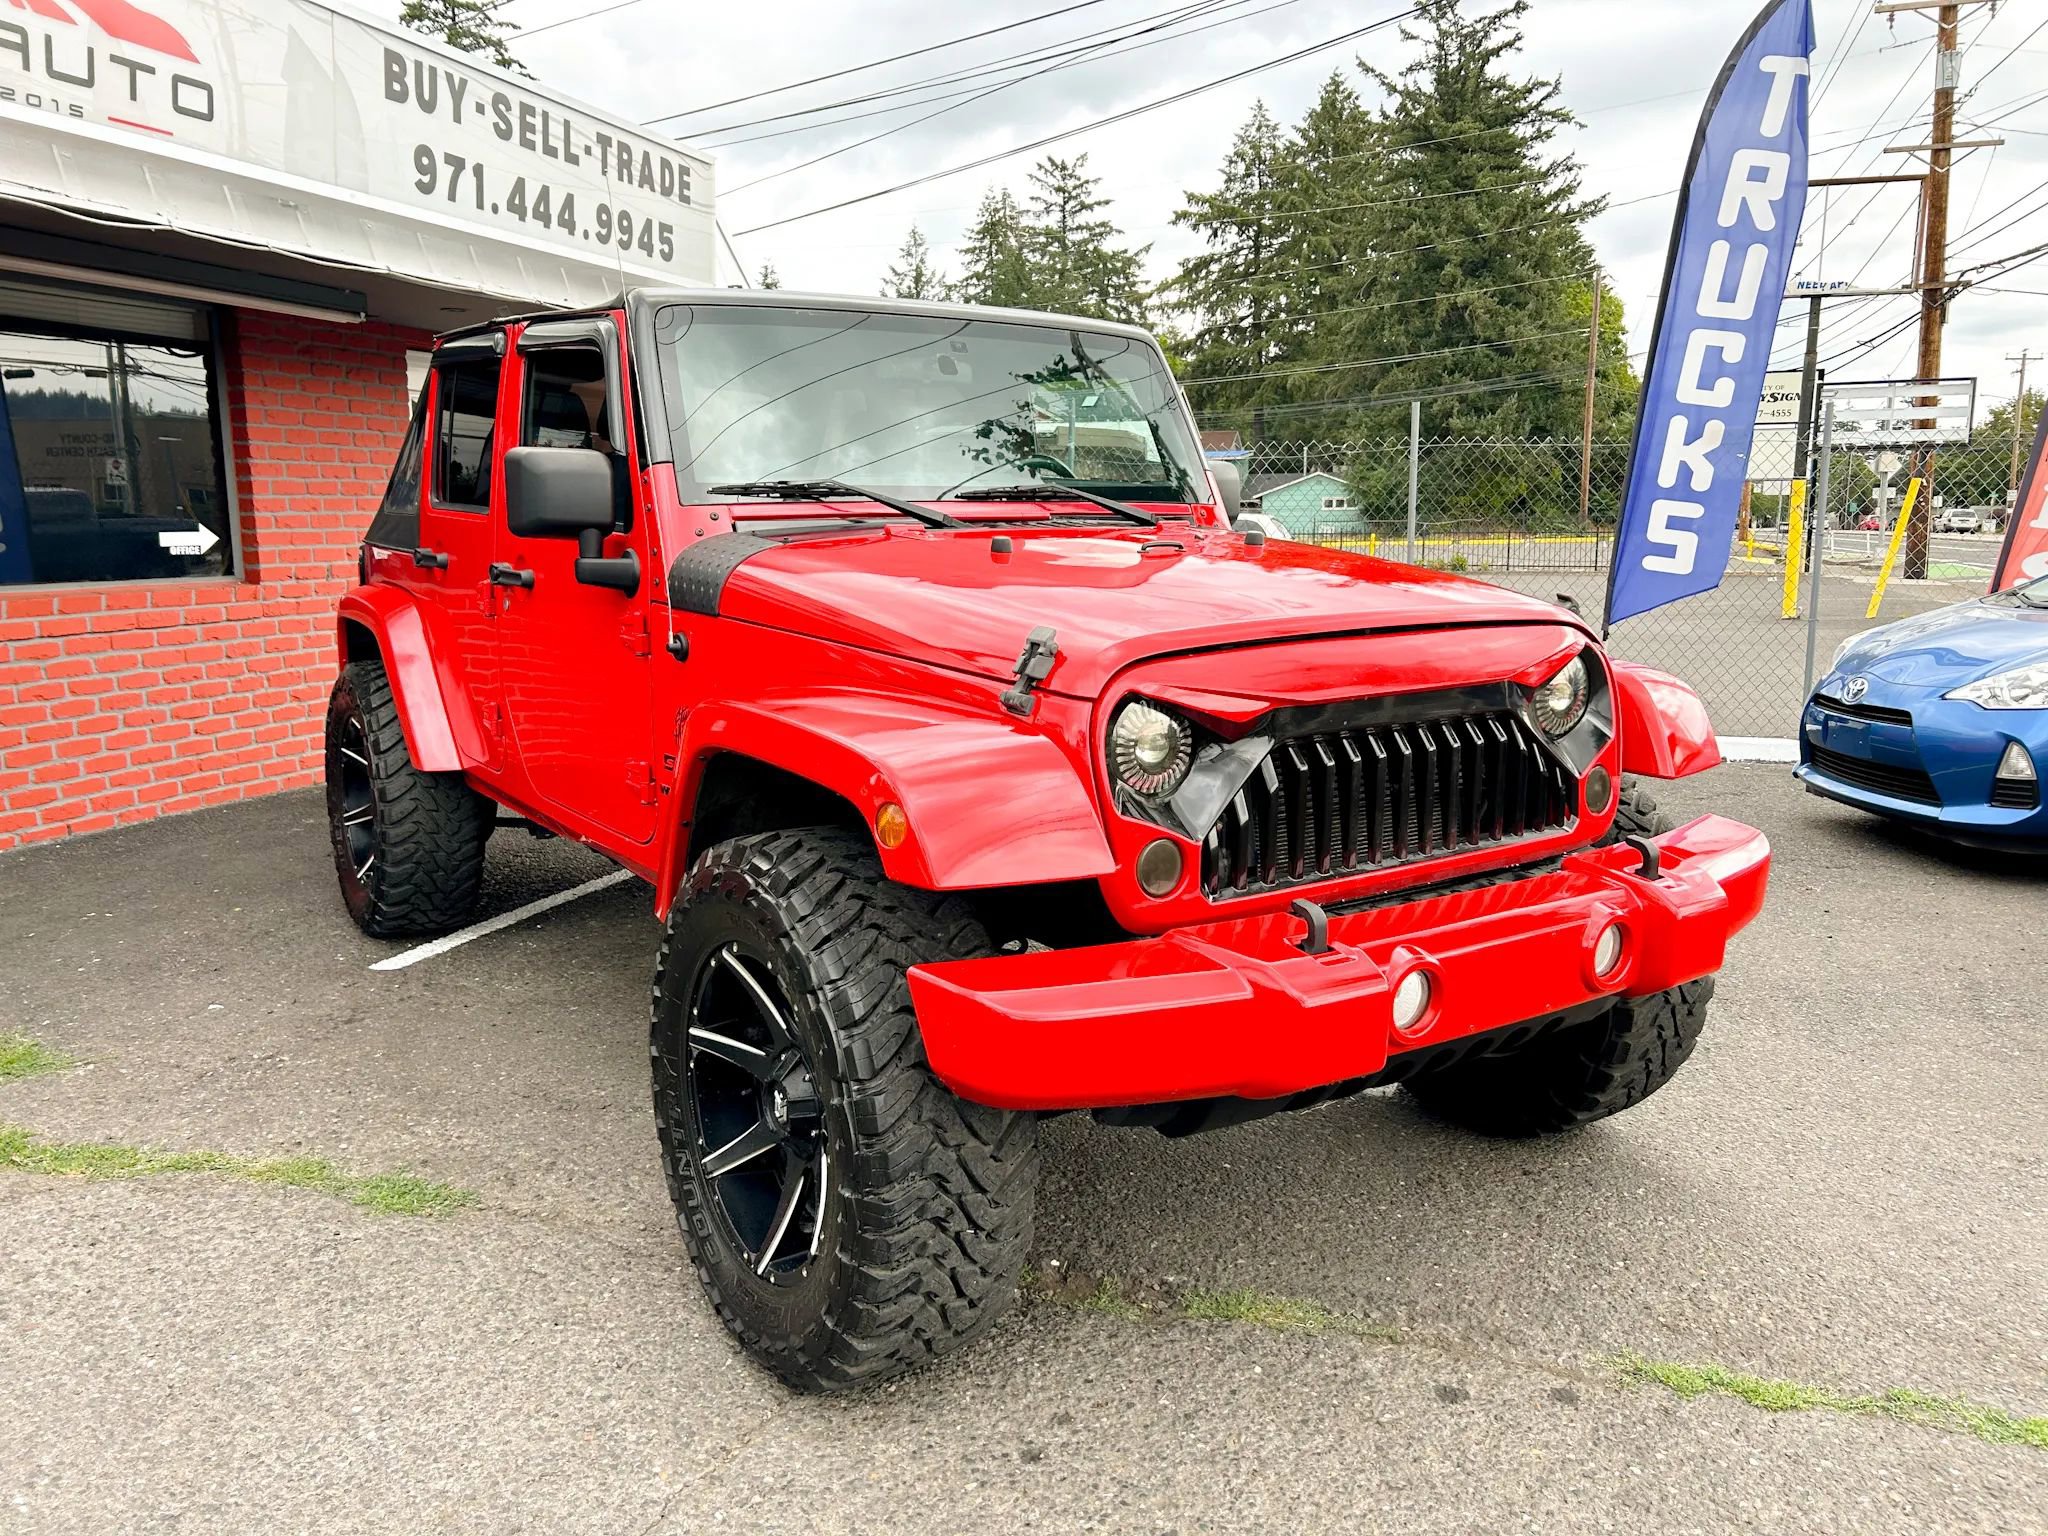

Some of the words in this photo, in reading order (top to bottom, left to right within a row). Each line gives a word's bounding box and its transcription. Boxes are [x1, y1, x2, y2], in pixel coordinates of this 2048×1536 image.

[0, 22, 214, 122] AUTO
[0, 86, 84, 119] 2015
[383, 46, 692, 206] BUY-SELL-TRADE
[413, 143, 674, 263] 971.444.9945
[1641, 55, 1808, 576] TRUCKS
[169, 546, 201, 556] OFFICE
